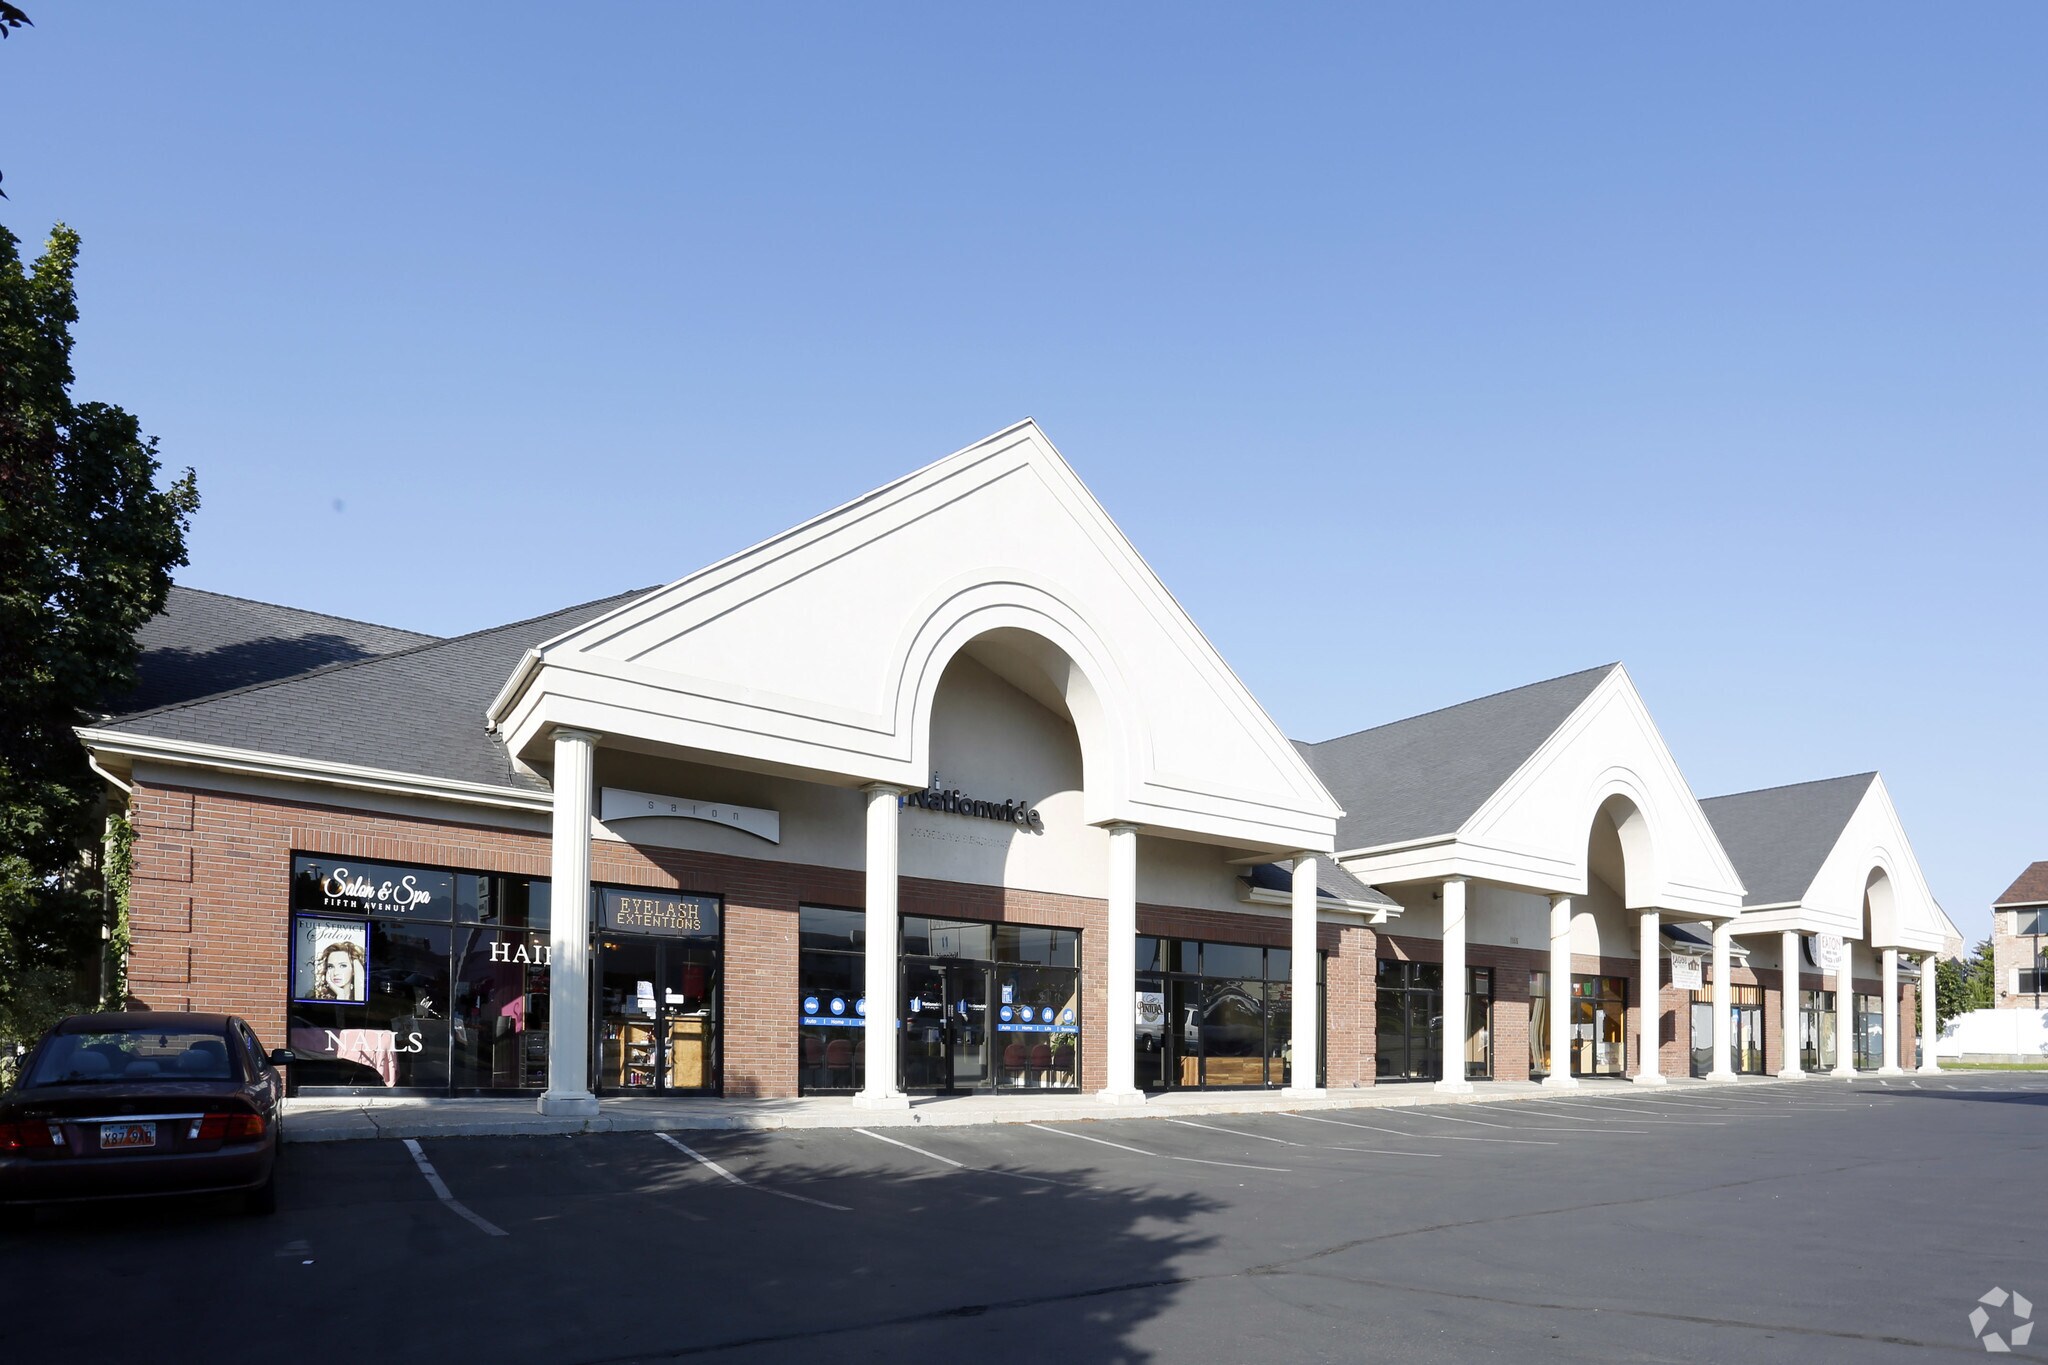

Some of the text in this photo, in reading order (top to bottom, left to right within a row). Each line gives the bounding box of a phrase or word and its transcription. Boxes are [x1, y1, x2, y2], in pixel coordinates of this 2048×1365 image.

[648, 801, 739, 821] salon
[908, 788, 1041, 827] Nationwide
[323, 867, 431, 910] Salon & Spa
[324, 898, 406, 912] FIFTH AVENUE
[620, 897, 699, 919] EYELASH
[617, 912, 701, 930] EXTENTIONS
[306, 928, 353, 944] Salon
[324, 1029, 423, 1053] NAILS
